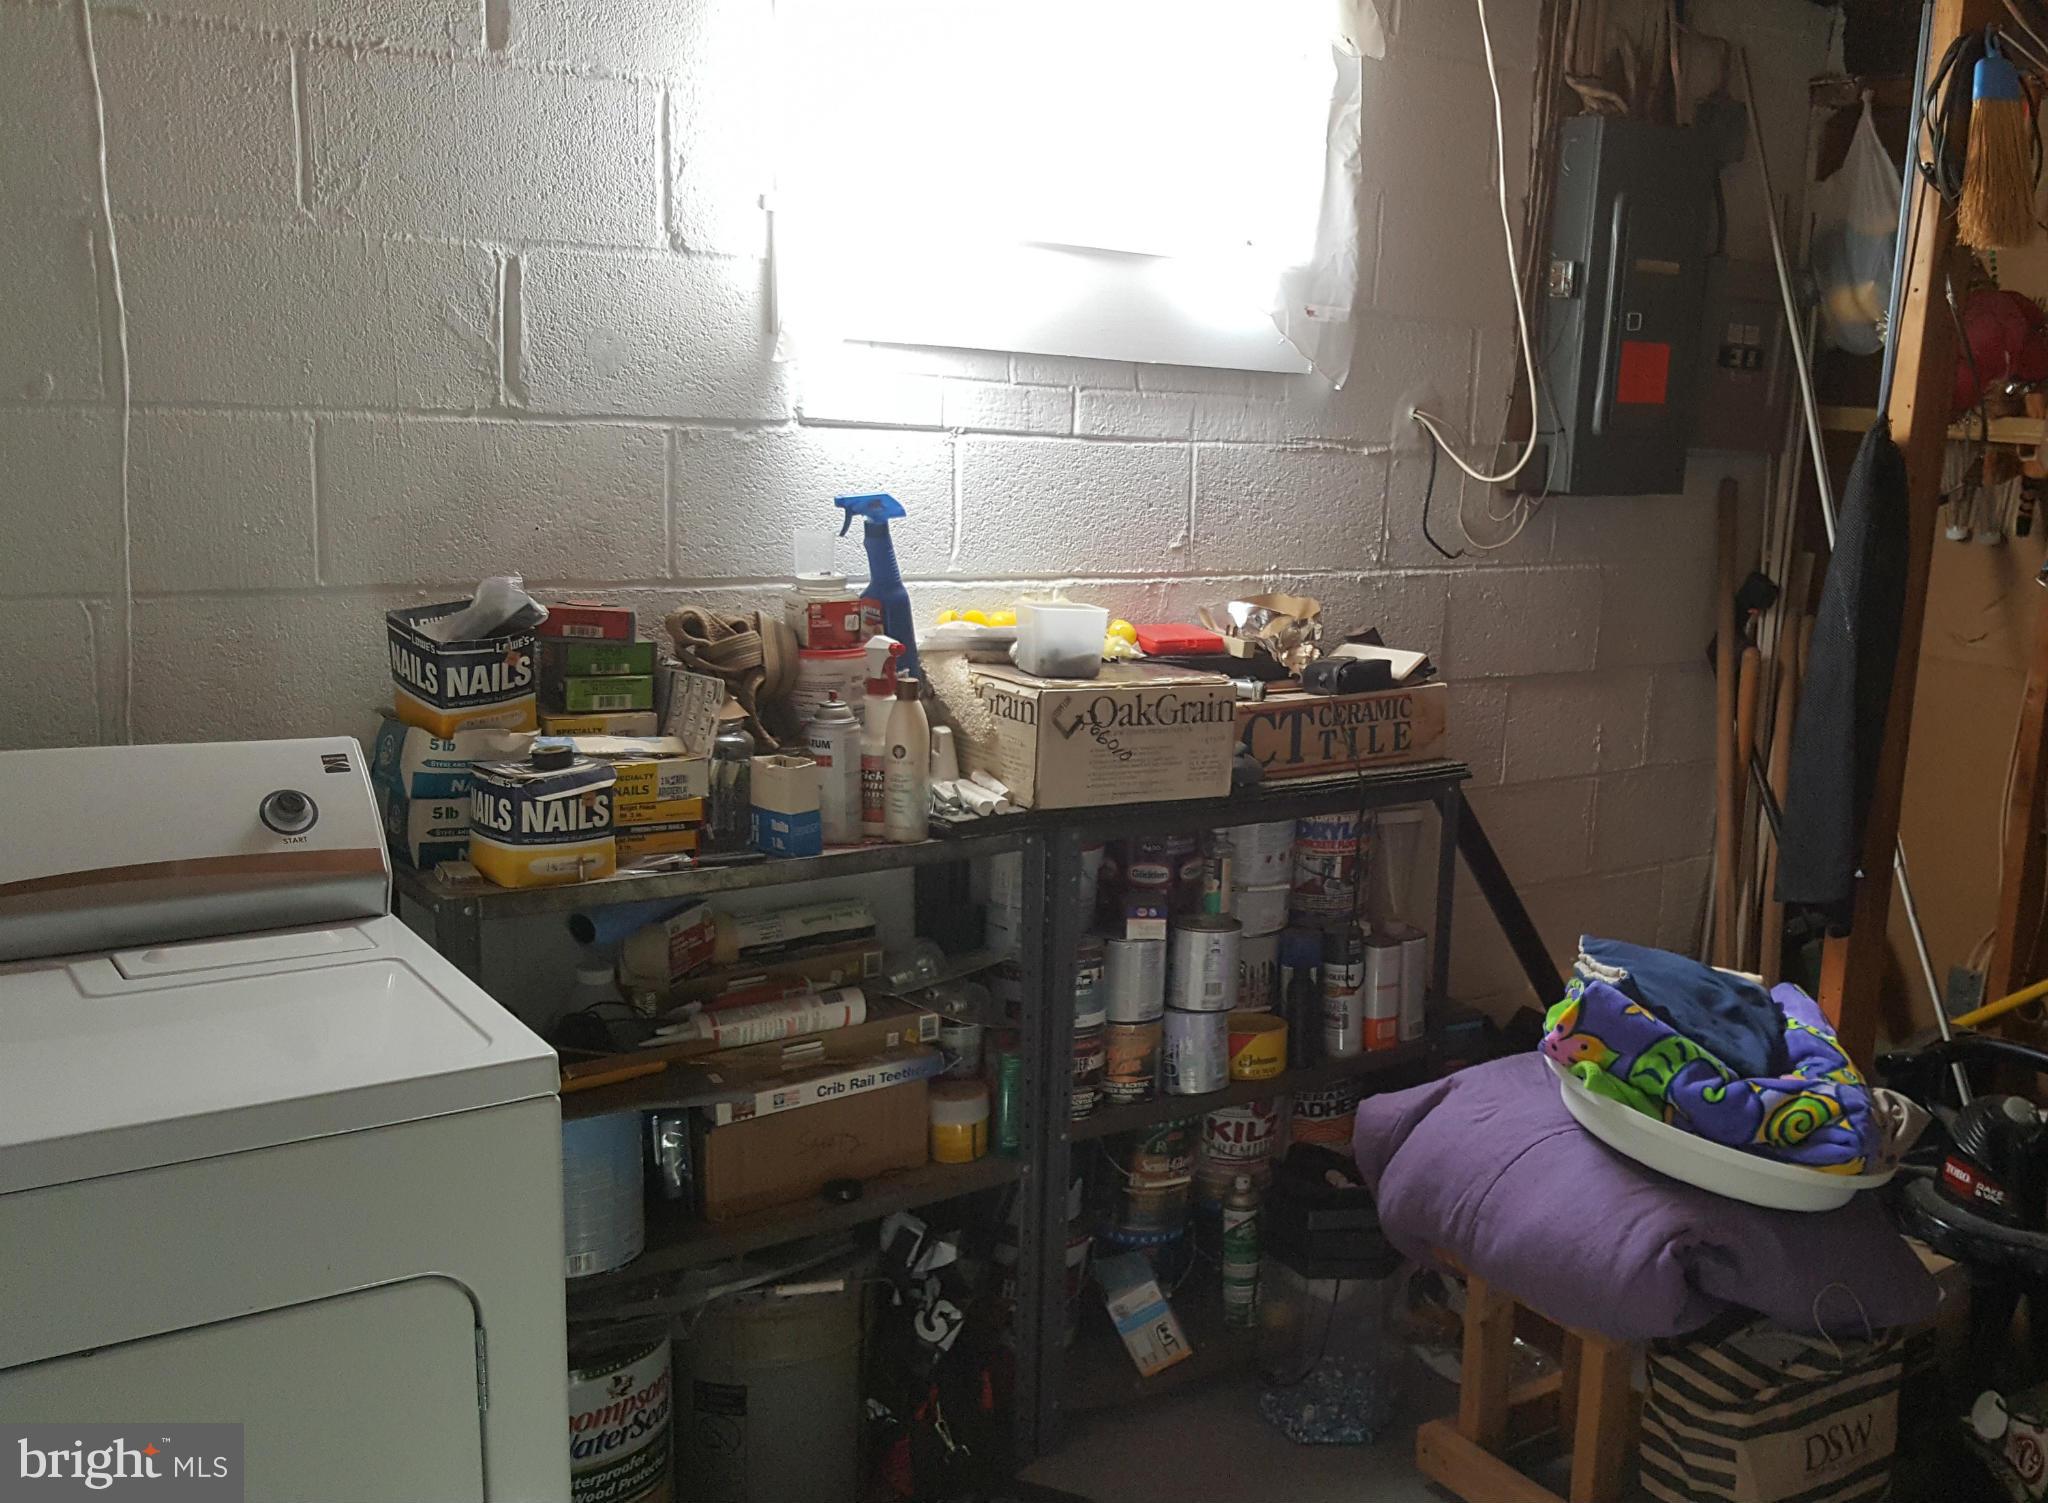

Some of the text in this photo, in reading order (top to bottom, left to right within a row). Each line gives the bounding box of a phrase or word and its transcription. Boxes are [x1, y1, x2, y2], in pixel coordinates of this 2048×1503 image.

[390, 641, 439, 696] NAILS
[446, 655, 532, 698] NAILS
[989, 692, 1037, 726] rain
[1089, 692, 1237, 728] OakGrain
[1319, 697, 1413, 727] CERAMIC
[430, 738, 457, 752] 5 lb
[1319, 721, 1412, 761] TILE
[432, 806, 459, 820] 5 lb
[471, 785, 512, 832] NAILS
[522, 794, 610, 833] NAILS
[817, 1082, 846, 1098] Crib
[850, 1074, 875, 1090] Rail
[1207, 1113, 1278, 1144] KILZ
[1806, 1413, 1872, 1472] DSW
